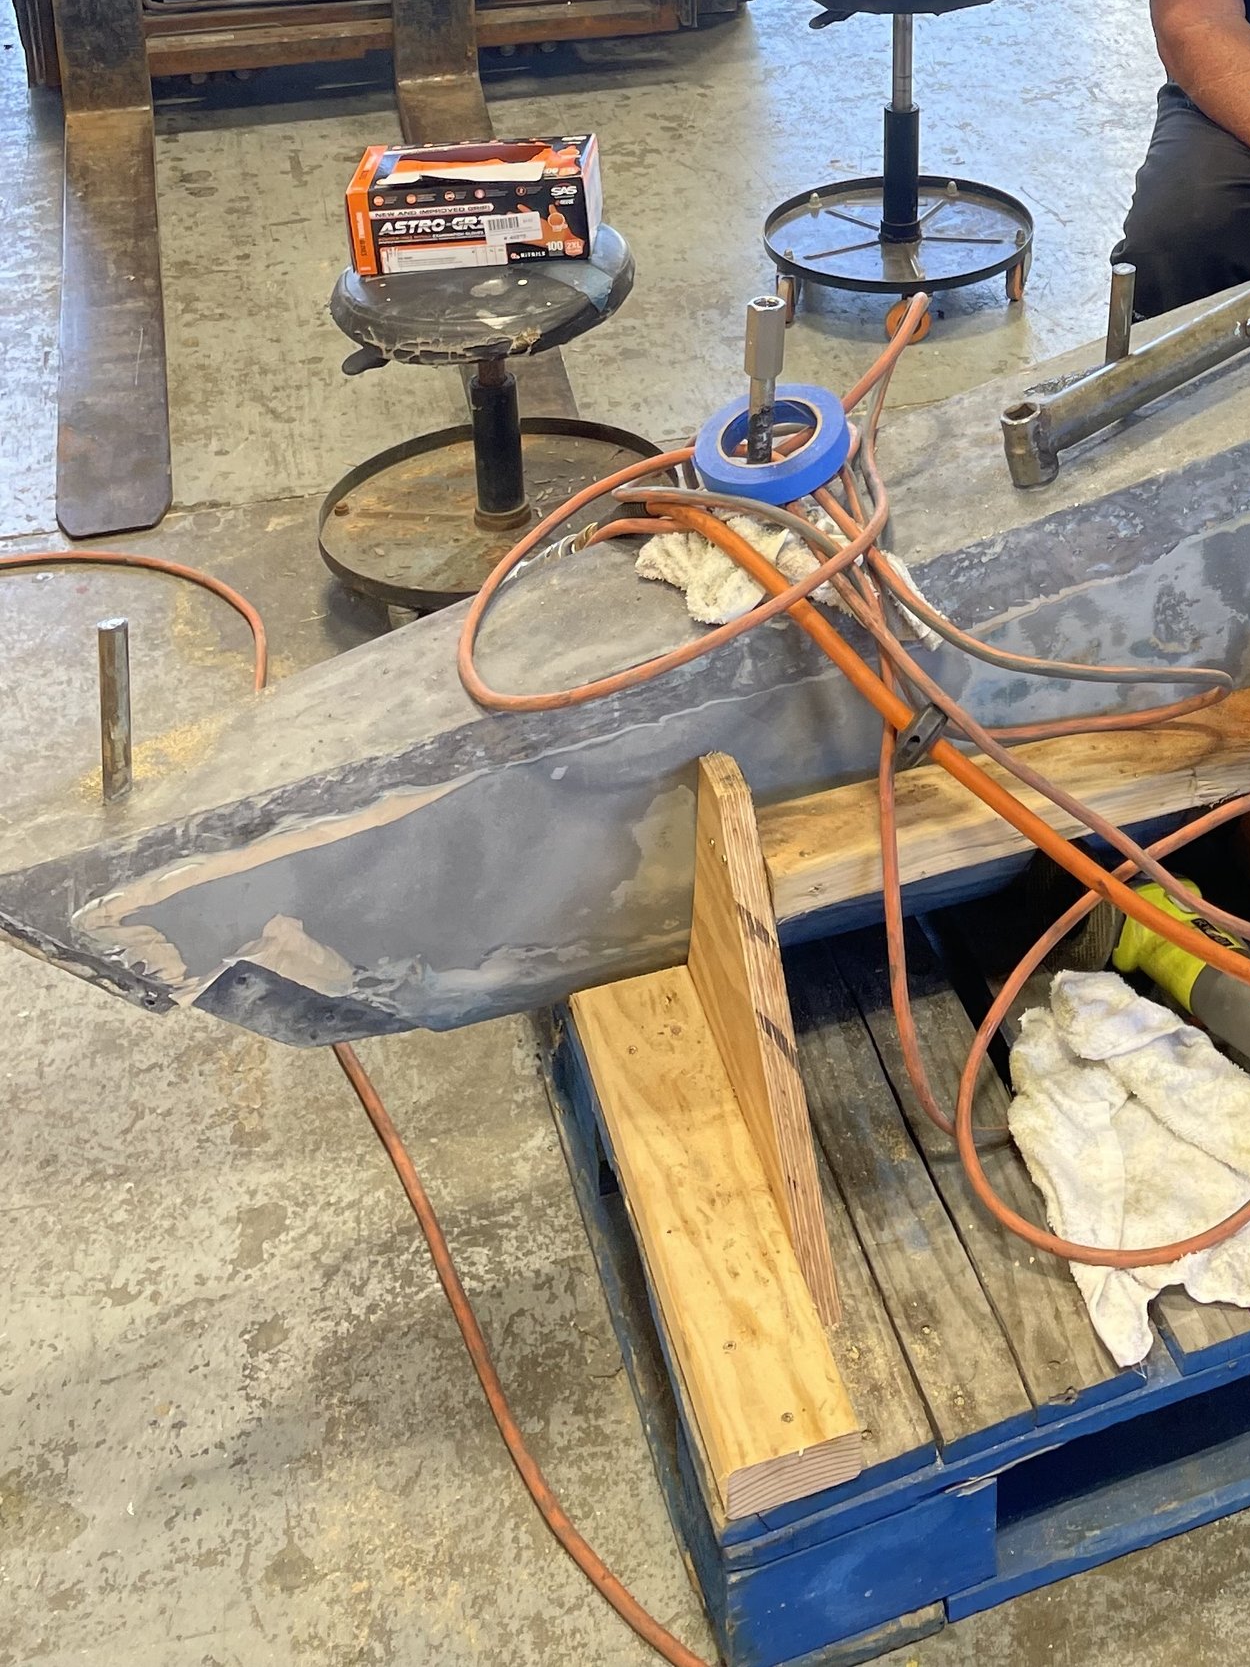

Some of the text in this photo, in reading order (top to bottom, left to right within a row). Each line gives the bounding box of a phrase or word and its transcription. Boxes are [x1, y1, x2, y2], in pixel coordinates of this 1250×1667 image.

[550, 185, 578, 196] SAS
[420, 207, 466, 215] IMPROVED
[546, 240, 564, 251] 100
